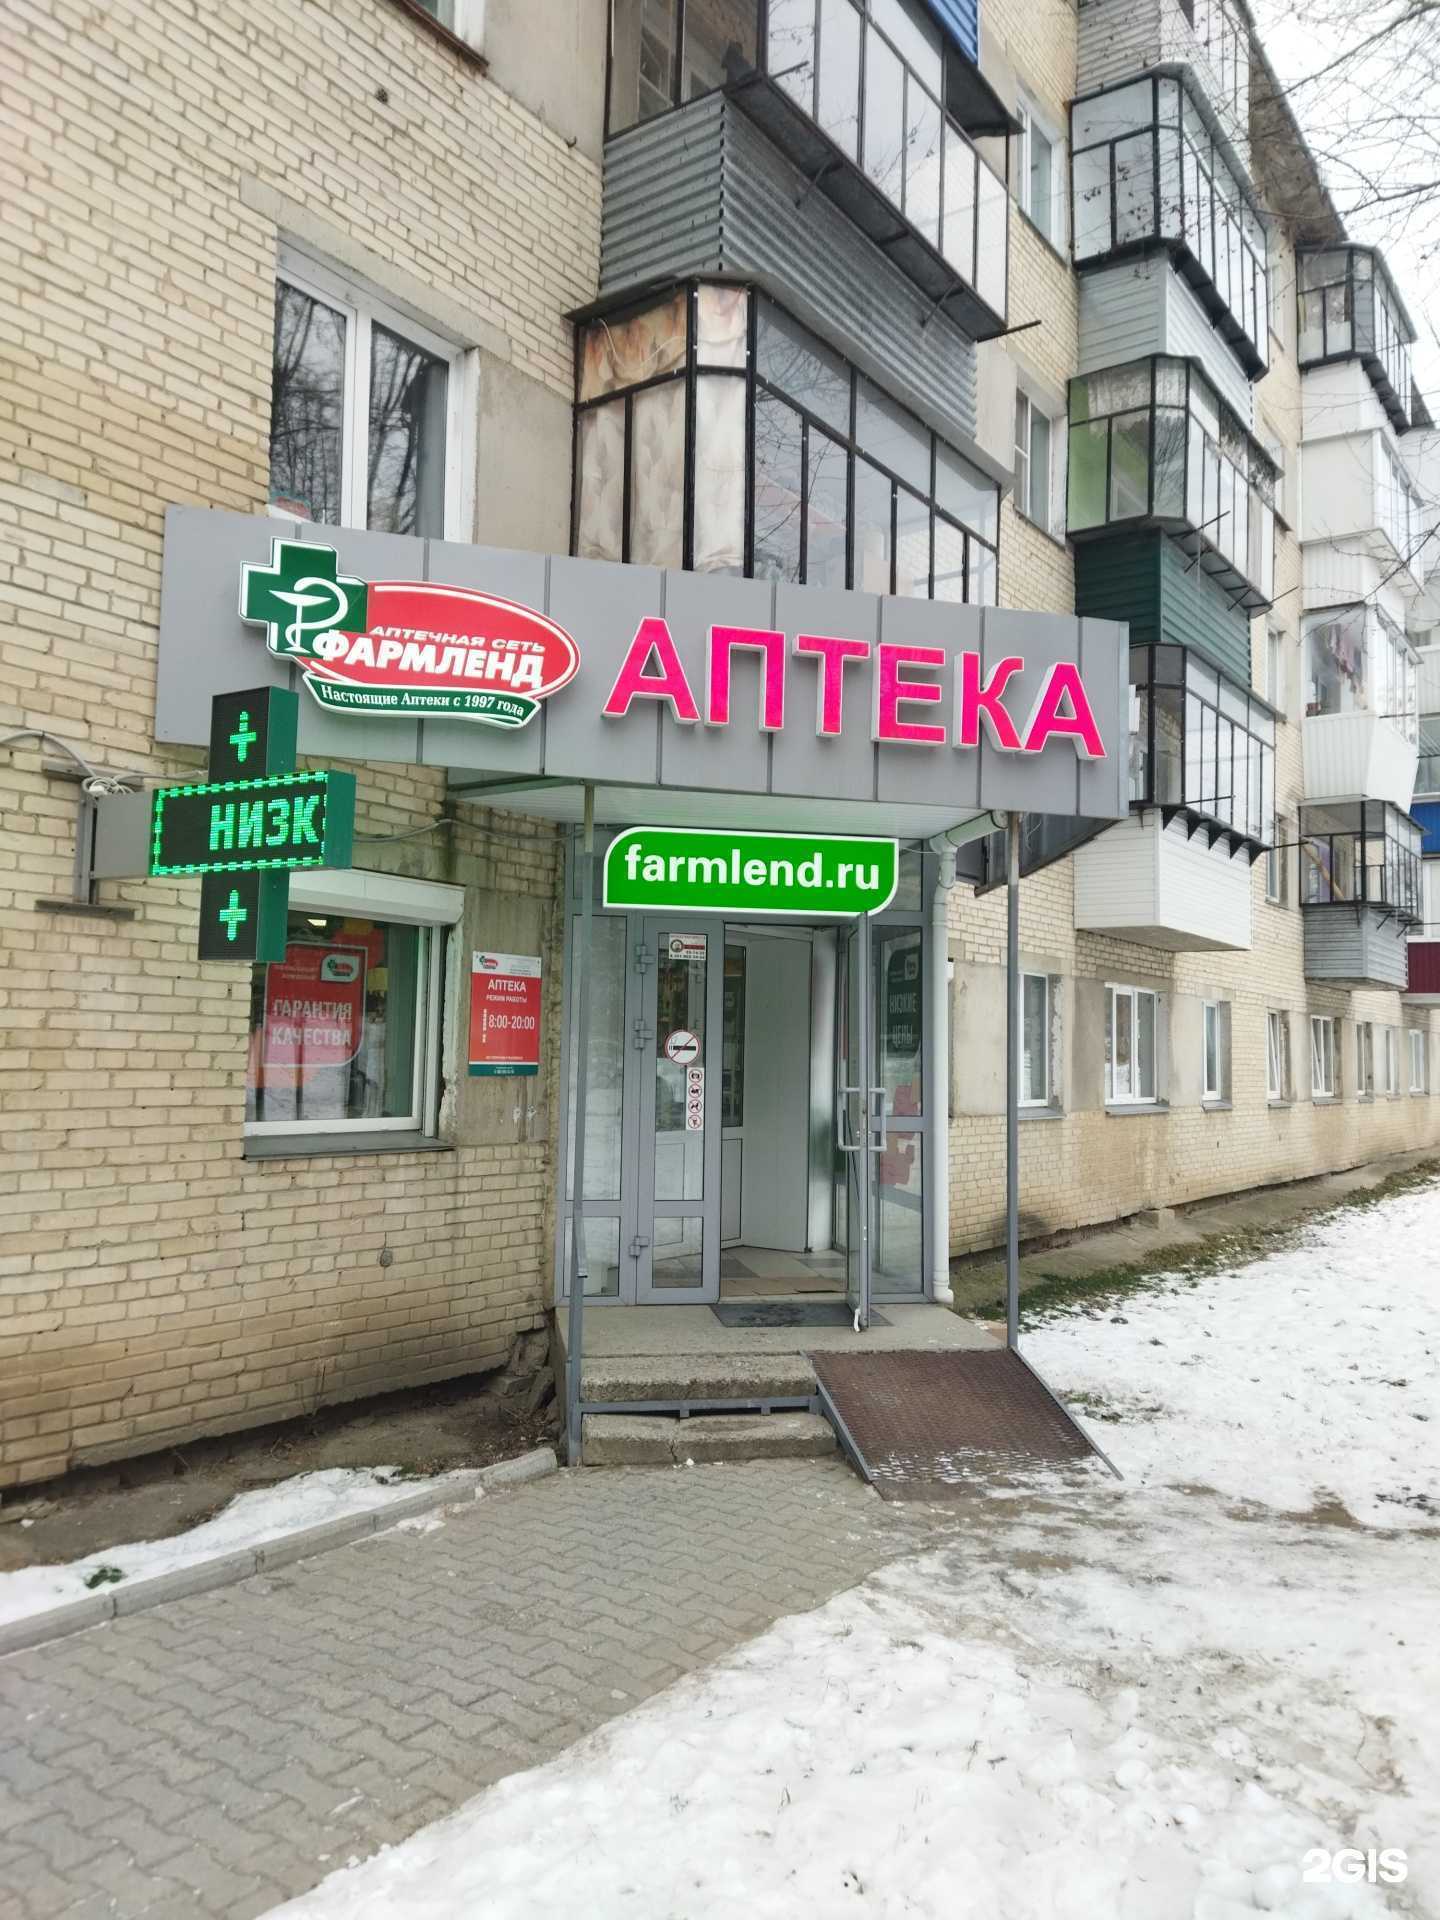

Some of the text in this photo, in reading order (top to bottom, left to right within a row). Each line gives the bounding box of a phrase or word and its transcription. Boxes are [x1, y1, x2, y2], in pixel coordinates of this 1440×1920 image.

[369, 626, 546, 653] АПТЕЧНАЯ СЕТЬ
[312, 629, 544, 689] ФАРМЛЕНД
[321, 684, 525, 717] Настоящие Аптеки с 1997 года
[602, 616, 1107, 761] АПТЕКА
[209, 795, 320, 850] НИЗК
[624, 843, 881, 891] farmlend.ru
[488, 979, 527, 992] АПТЕКА
[273, 998, 353, 1019] ГАРАНТИЯ
[488, 1014, 535, 1030] 8:00-20:00
[271, 1025, 352, 1045] КАЧЕСТВА
